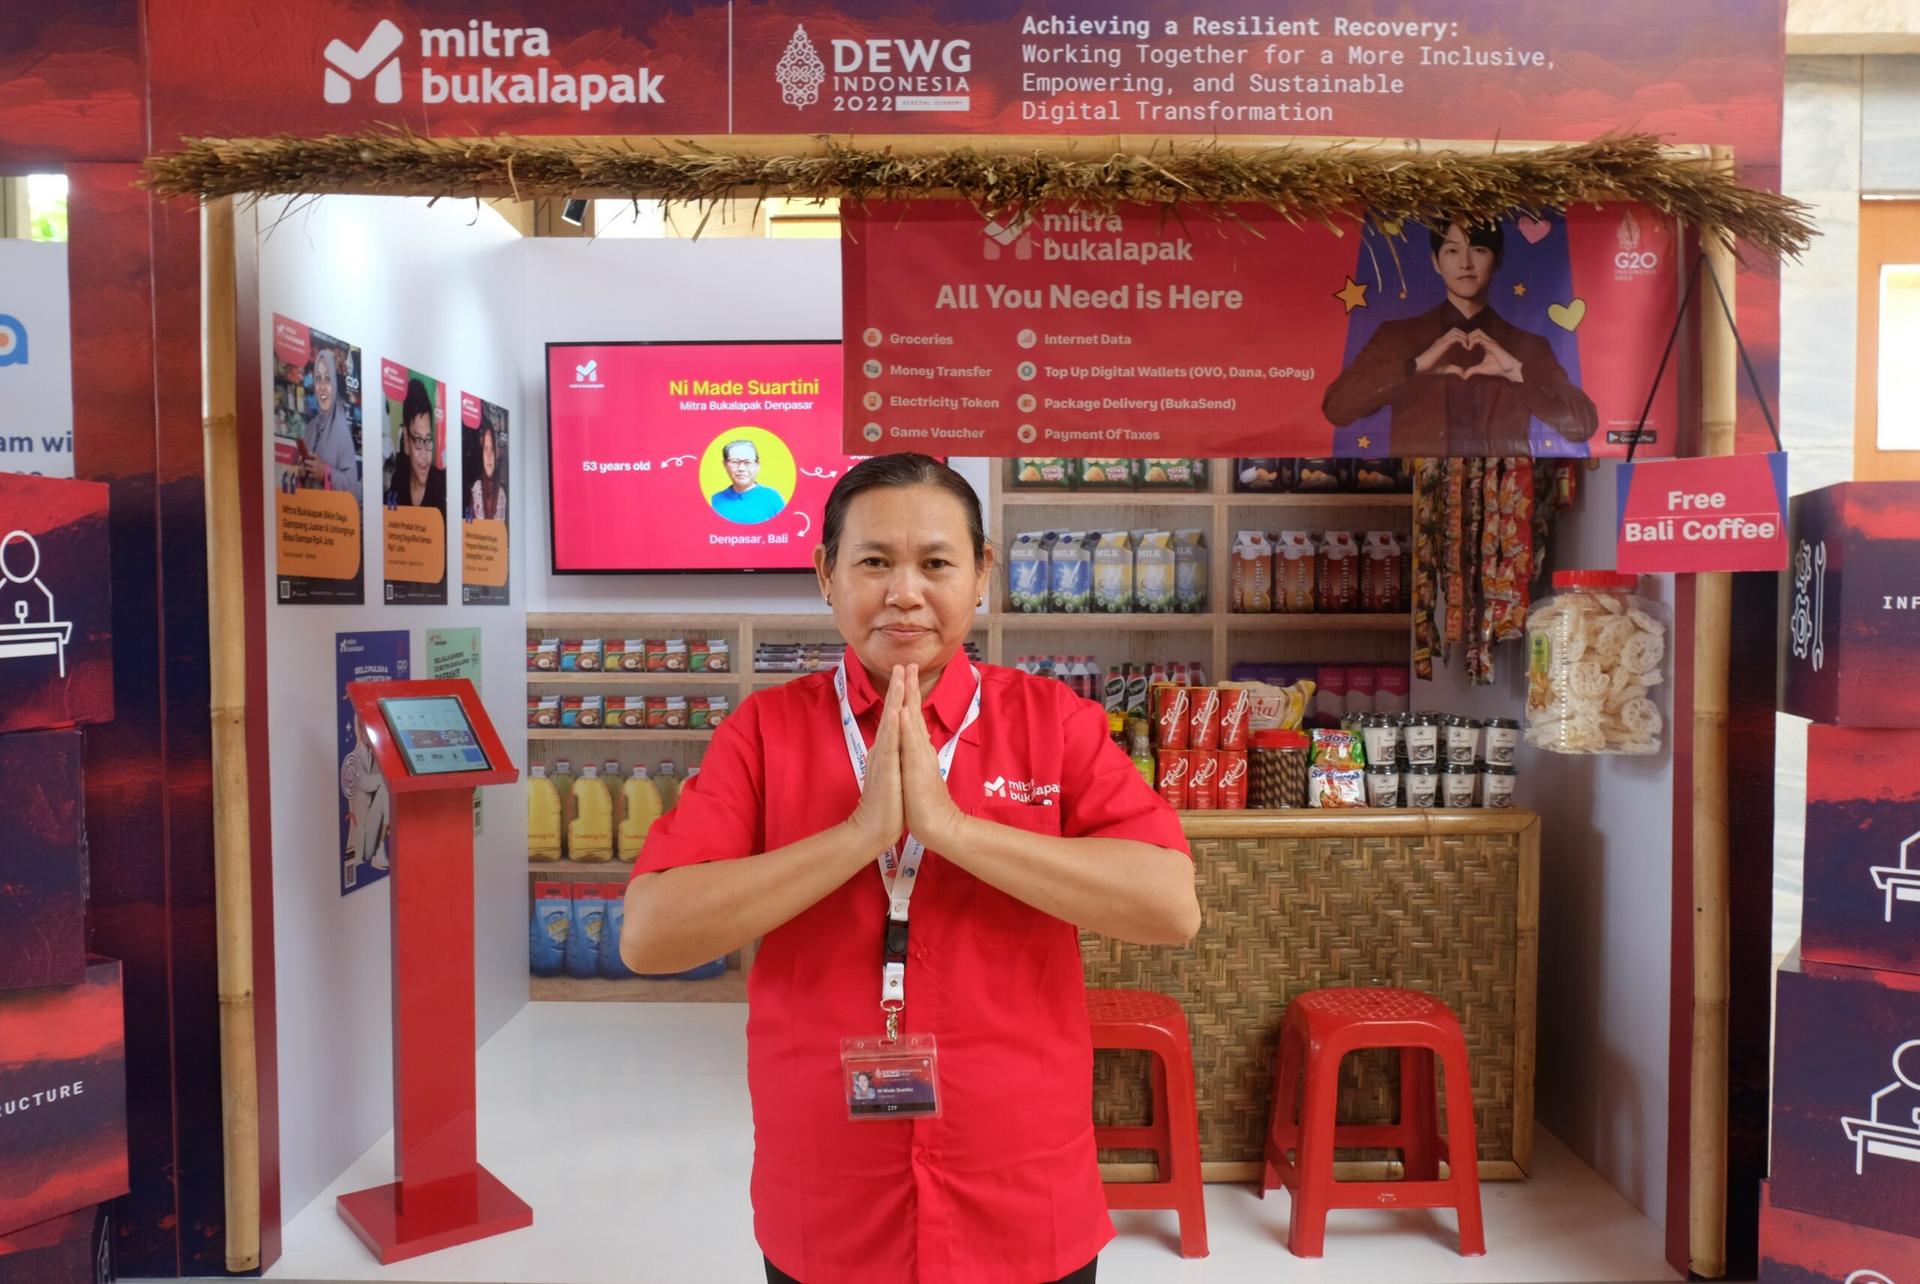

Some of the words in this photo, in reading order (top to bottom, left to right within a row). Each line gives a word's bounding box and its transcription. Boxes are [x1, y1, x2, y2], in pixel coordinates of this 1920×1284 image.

[1022, 16, 1150, 38] Achieving
[1164, 21, 1178, 36] a
[1193, 16, 1320, 36] Resilient
[1334, 17, 1460, 40] Recovery:
[421, 20, 550, 57] mitra
[832, 39, 972, 73] DEWG
[1022, 46, 1122, 67] Working
[1139, 46, 1248, 68] Together
[1265, 46, 1305, 66] for
[1320, 51, 1334, 66] a
[1348, 48, 1404, 67] More
[1420, 47, 1556, 72] Inclusive,
[421, 68, 665, 110] bukalapak
[833, 76, 971, 92] INDONESIA
[1022, 74, 1174, 97] Empowering,
[1192, 74, 1235, 94] and
[1249, 74, 1404, 95] Sustainable
[834, 96, 892, 111] 2022
[1022, 102, 1122, 124] Digital
[1138, 102, 1334, 123] Transformation
[1043, 210, 1123, 233] mitra
[1043, 237, 1194, 266] bukalapak
[1614, 252, 1657, 269] G20
[936, 284, 979, 309] All
[986, 284, 1043, 310] You
[1050, 283, 1129, 309] Need
[1137, 283, 1162, 309] is
[1169, 284, 1244, 309] Here
[890, 333, 953, 345] Groceries
[1044, 333, 1098, 346] Internet
[1101, 333, 1132, 346] Data
[890, 366, 933, 381] Money
[937, 365, 993, 378] Transfer
[1044, 366, 1067, 381] Top
[1070, 366, 1088, 381] Up
[1091, 366, 1137, 381] Digital
[1140, 366, 1187, 378] Wallets
[1189, 365, 1227, 381] (OVO,
[1229, 366, 1266, 381] Dana,
[1268, 366, 1315, 381] GoPay)
[669, 382, 688, 396] Ni
[692, 380, 742, 396] Made
[747, 379, 820, 395] Suartini
[680, 401, 707, 411] Mitra
[709, 400, 762, 412] Bukalapak
[764, 400, 813, 412] Denpasar
[890, 396, 958, 411] Electricity
[961, 397, 1000, 409] Token
[1044, 397, 1100, 413] Package
[1103, 397, 1158, 413] Delivery
[1160, 397, 1237, 413] (BukaSend)
[890, 427, 927, 439] Game
[931, 427, 985, 439] Voucher
[1044, 428, 1102, 444] Payment
[1105, 428, 1121, 441] Of
[1123, 429, 1160, 441] Taxes
[583, 461, 597, 471] 53
[600, 462, 630, 474] years
[633, 460, 651, 471] old
[1667, 491, 1726, 510] Free
[1625, 521, 1674, 542] Bali
[1682, 518, 1775, 541] Coffee
[768, 534, 788, 544] Bali
